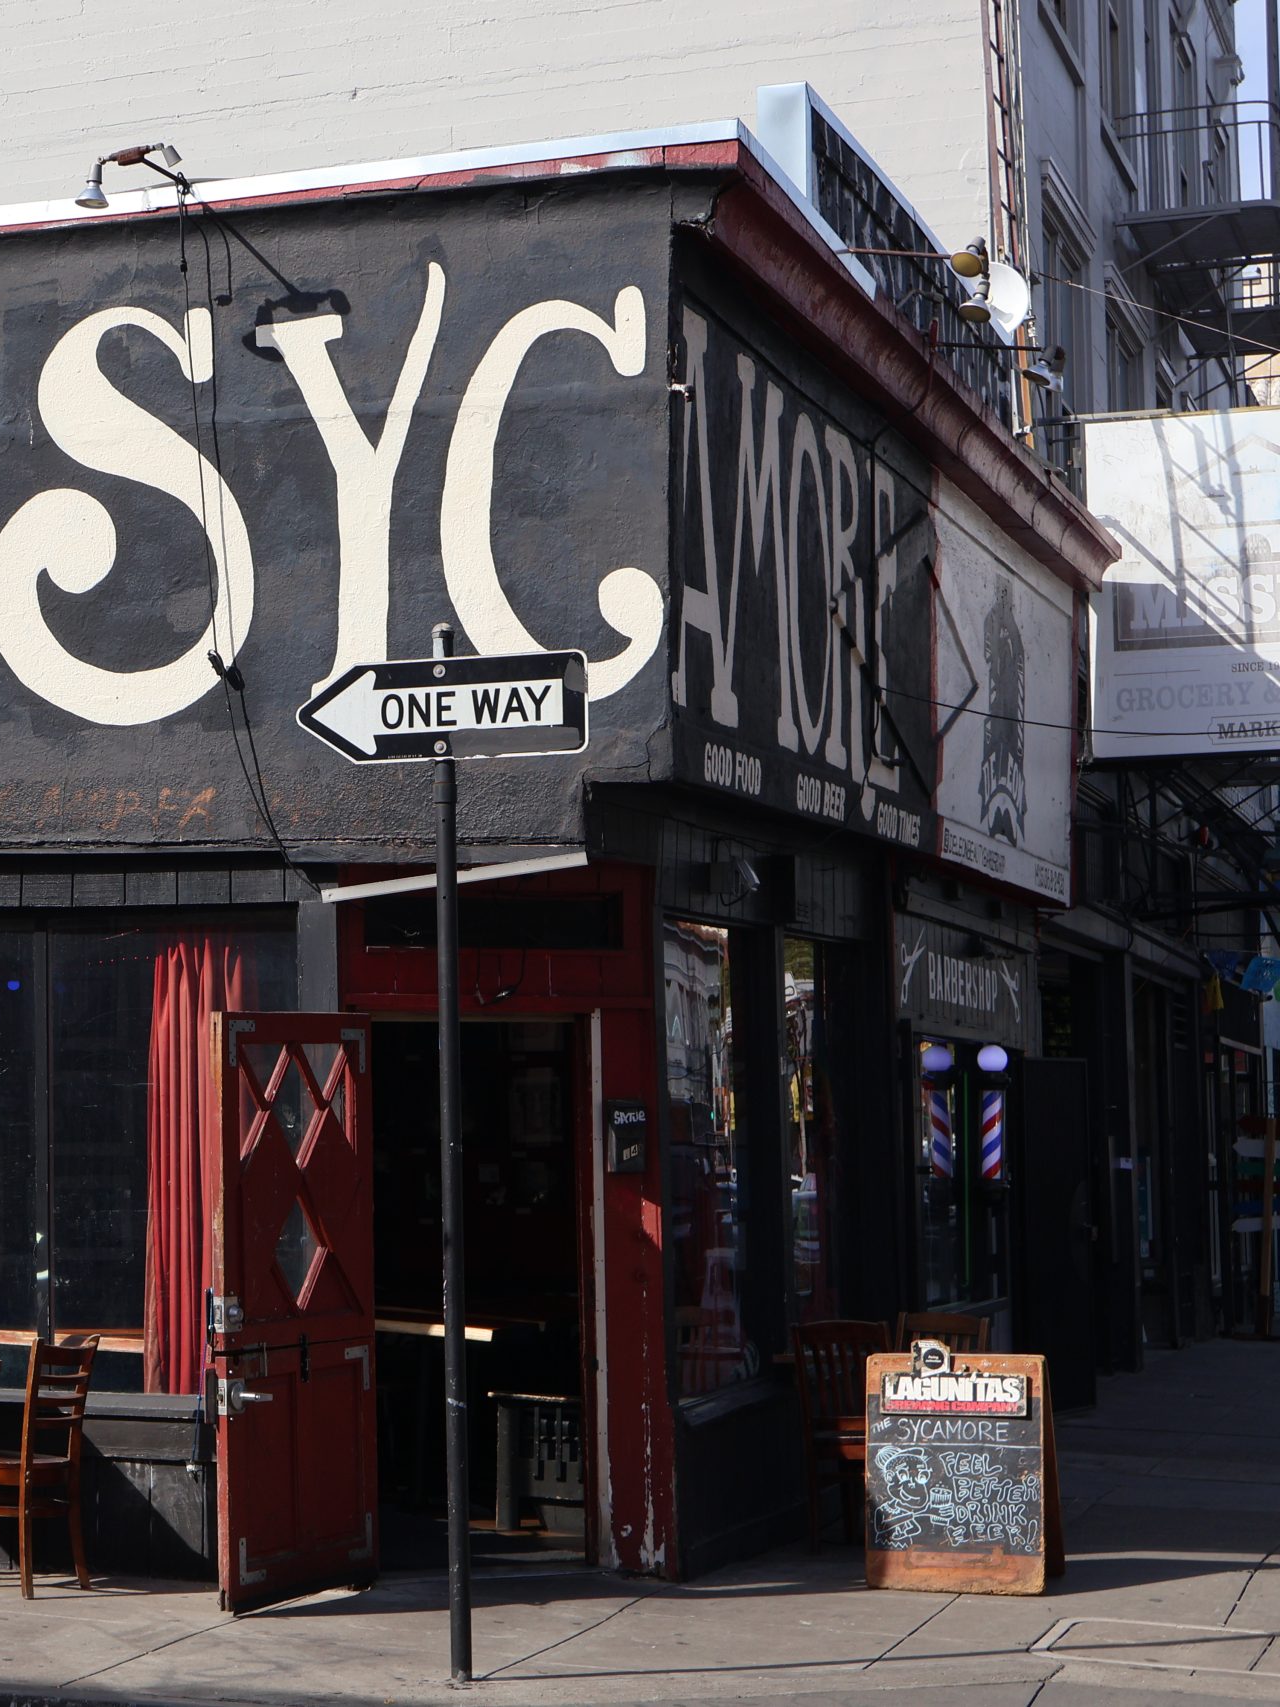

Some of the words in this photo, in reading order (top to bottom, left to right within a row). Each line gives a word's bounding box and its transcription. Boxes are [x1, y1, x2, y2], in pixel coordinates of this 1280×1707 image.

[1130, 574, 1280, 629] MISS
[1231, 661, 1264, 673] SINCE
[381, 691, 457, 729] ONE
[471, 685, 552, 725] WAY
[1116, 681, 1255, 713] GROCERY
[704, 742, 732, 787] GOOD
[735, 752, 762, 796] FOOD
[797, 773, 821, 814] GOOD
[823, 781, 846, 822] BEER
[877, 802, 898, 838] GOOD
[899, 809, 921, 848] TIMES
[928, 951, 998, 1014] BARBERSHOP
[885, 1374, 1021, 1403] LAGUNITAS
[871, 1417, 893, 1434] THE
[897, 1418, 1010, 1442] SYCAMORE
[939, 1451, 1003, 1477] FEEL
[952, 1474, 1039, 1503] BETTER
